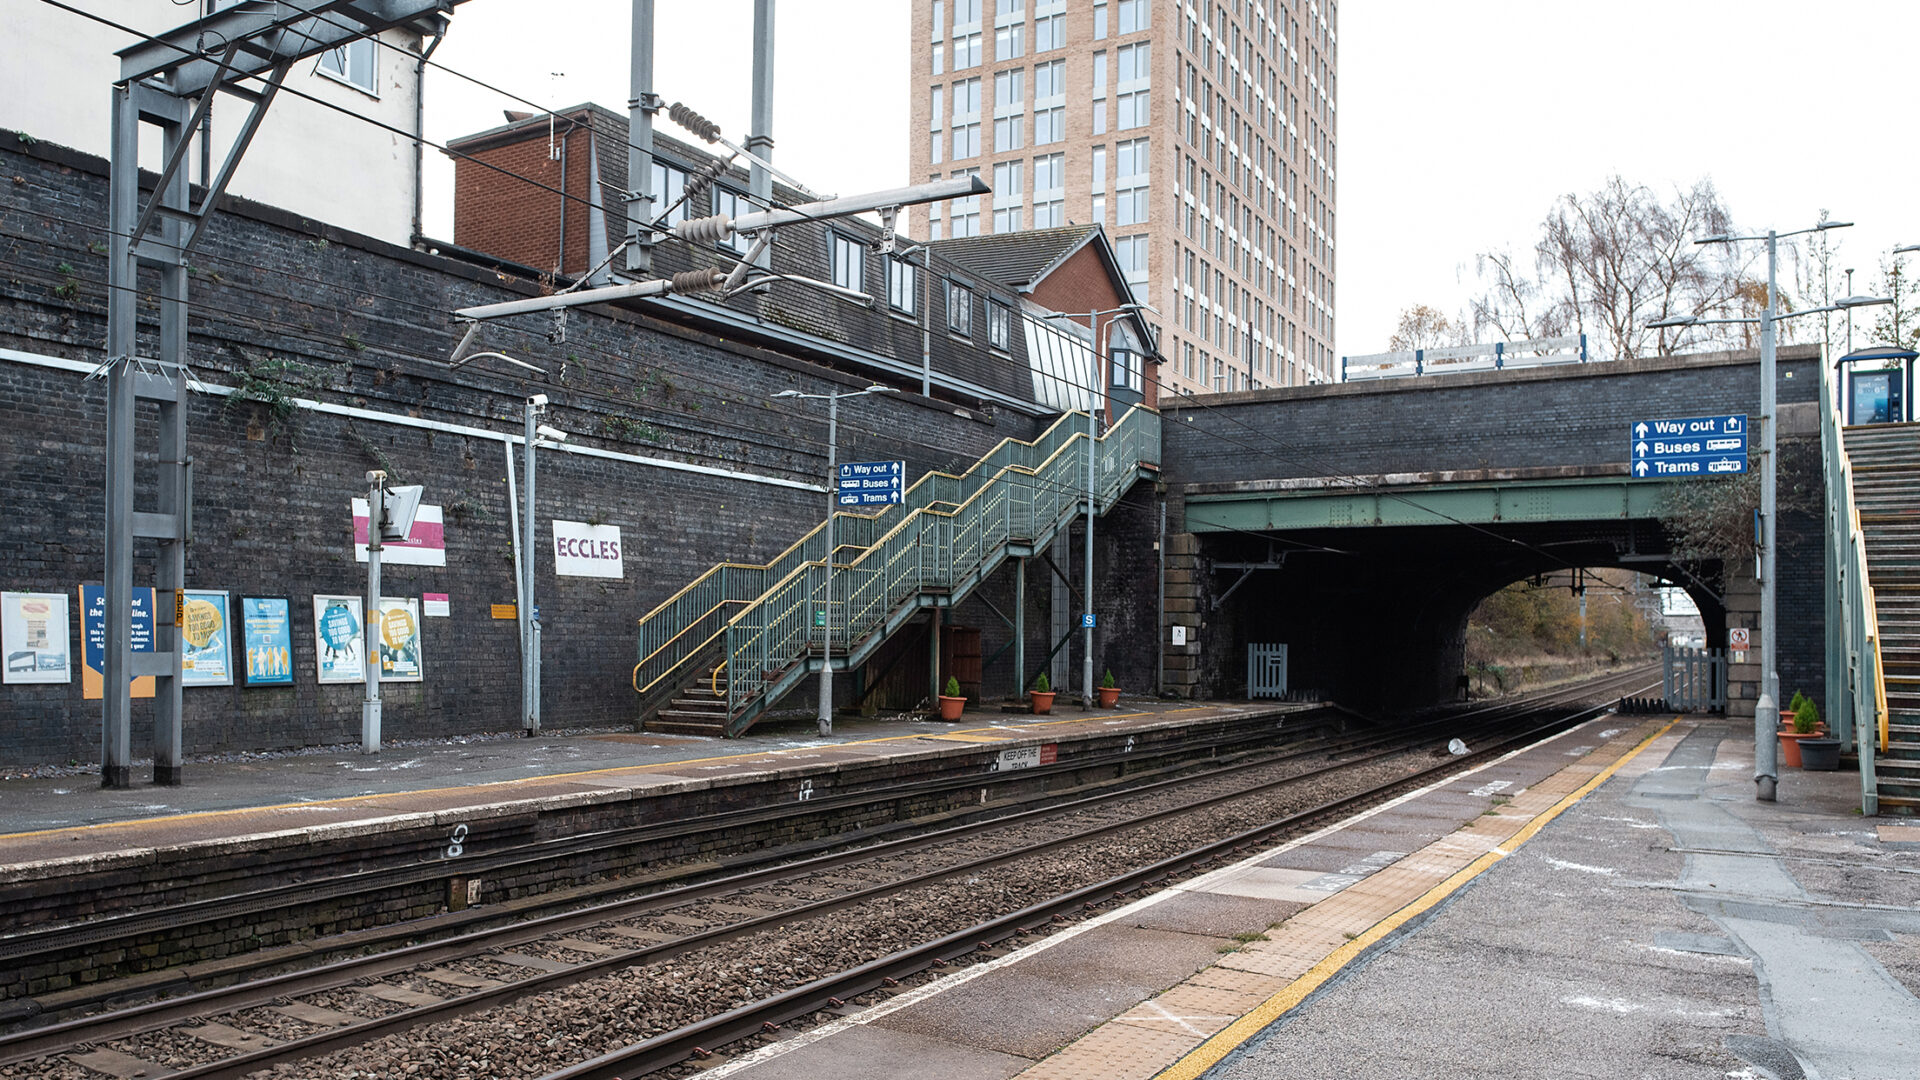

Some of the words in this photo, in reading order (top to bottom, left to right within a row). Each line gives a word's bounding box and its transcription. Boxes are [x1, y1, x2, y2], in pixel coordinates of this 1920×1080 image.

[1654, 421, 1686, 435] Way
[1690, 419, 1715, 432] out
[1654, 442, 1700, 454] Buses
[853, 465, 872, 475] Way
[873, 464, 887, 473] out
[1654, 461, 1700, 473] Trams
[862, 479, 889, 488] Buses
[862, 493, 888, 502] Trams
[556, 536, 620, 560] ECCLES
[89, 608, 103, 617] the
[1085, 615, 1093, 625] S
[1004, 750, 1017, 761] KEEP
[1017, 749, 1027, 759] OFF
